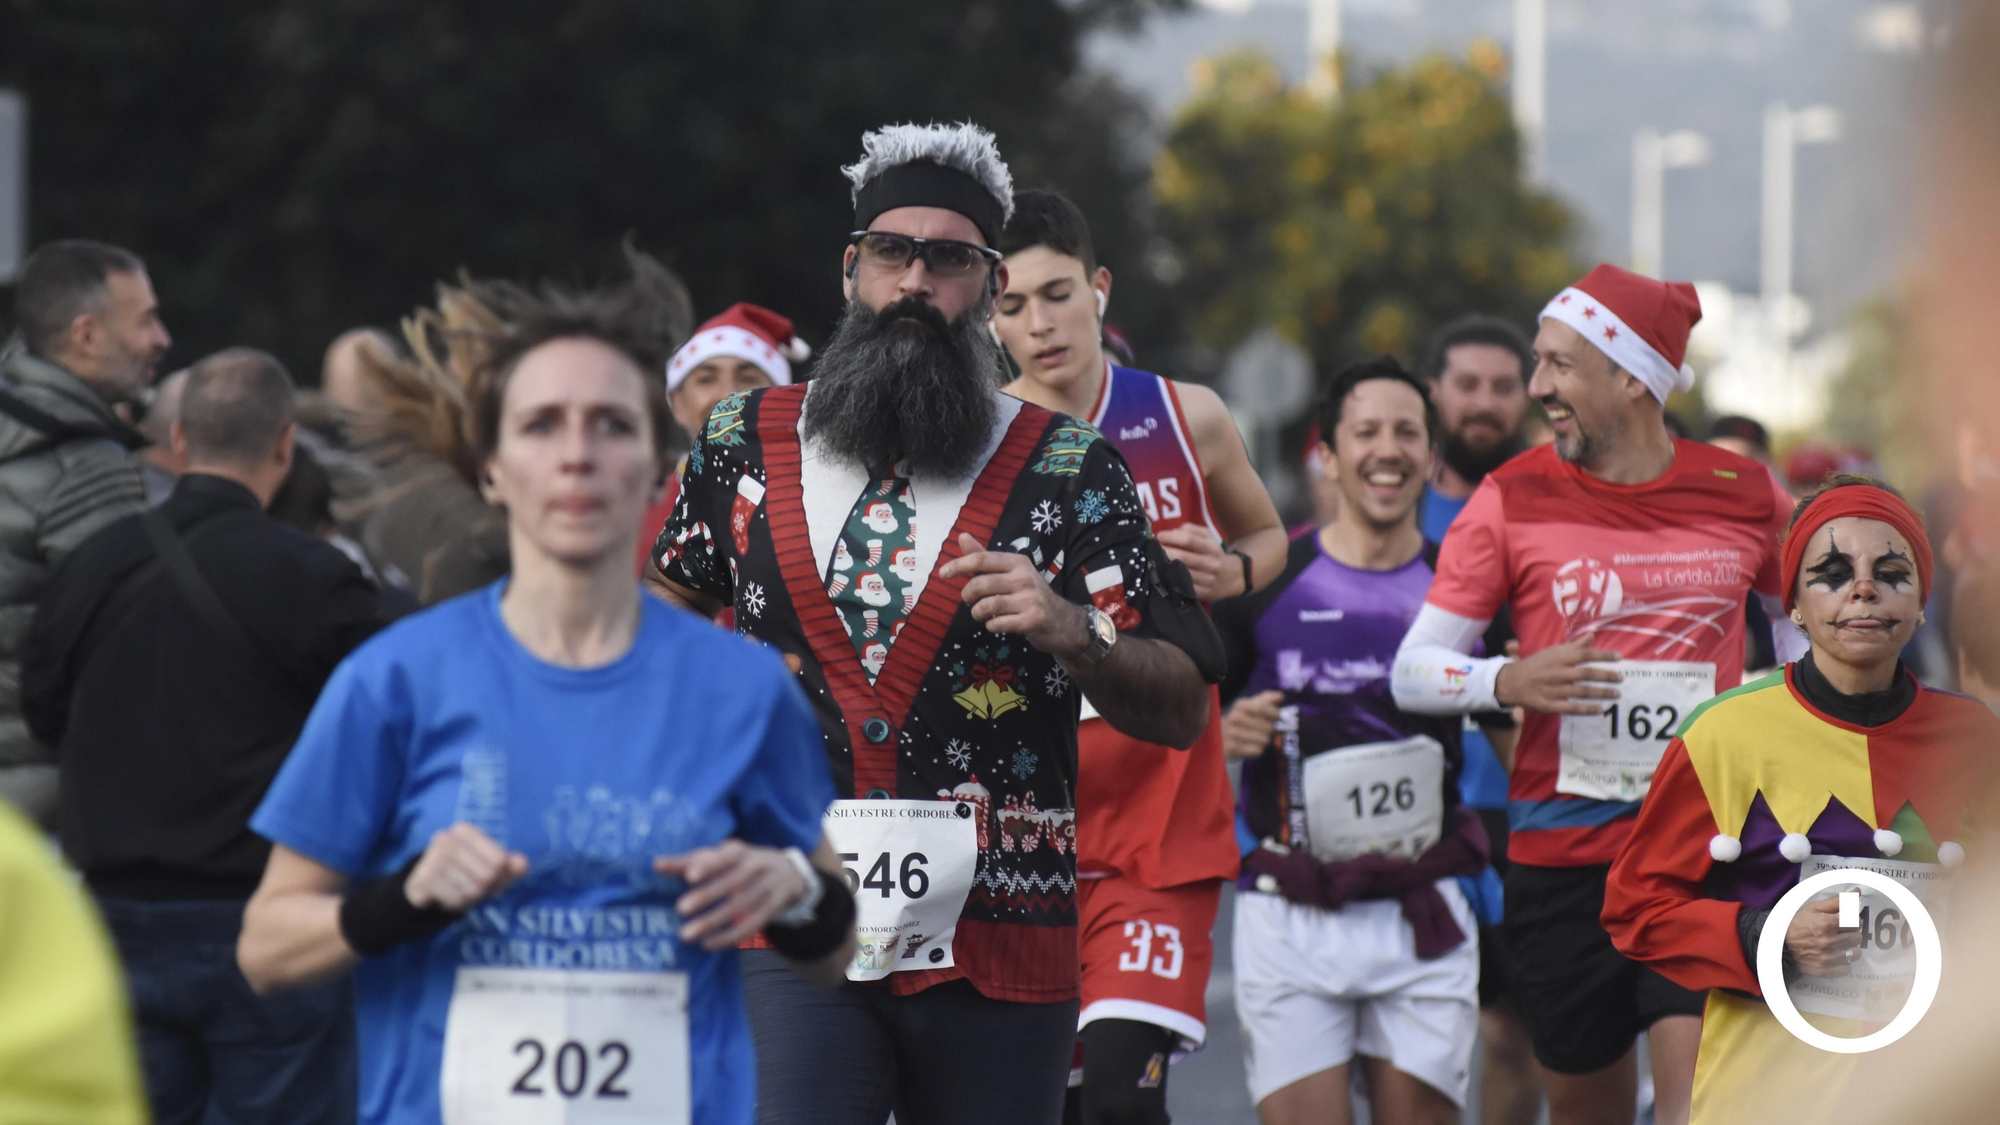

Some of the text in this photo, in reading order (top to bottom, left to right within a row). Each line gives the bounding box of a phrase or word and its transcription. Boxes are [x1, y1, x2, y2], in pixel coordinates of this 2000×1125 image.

[1712, 560, 1741, 585] 2022
[1603, 703, 1678, 740] 162
[834, 808, 897, 818] SILVESTRE
[899, 809, 962, 820] CORDOBES
[1348, 778, 1415, 819] 126
[836, 852, 929, 899] 546
[516, 902, 676, 937] SILVESTR
[1119, 919, 1184, 980] 33
[1810, 984, 1860, 999] IMDECO
[510, 1040, 632, 1099] 202
